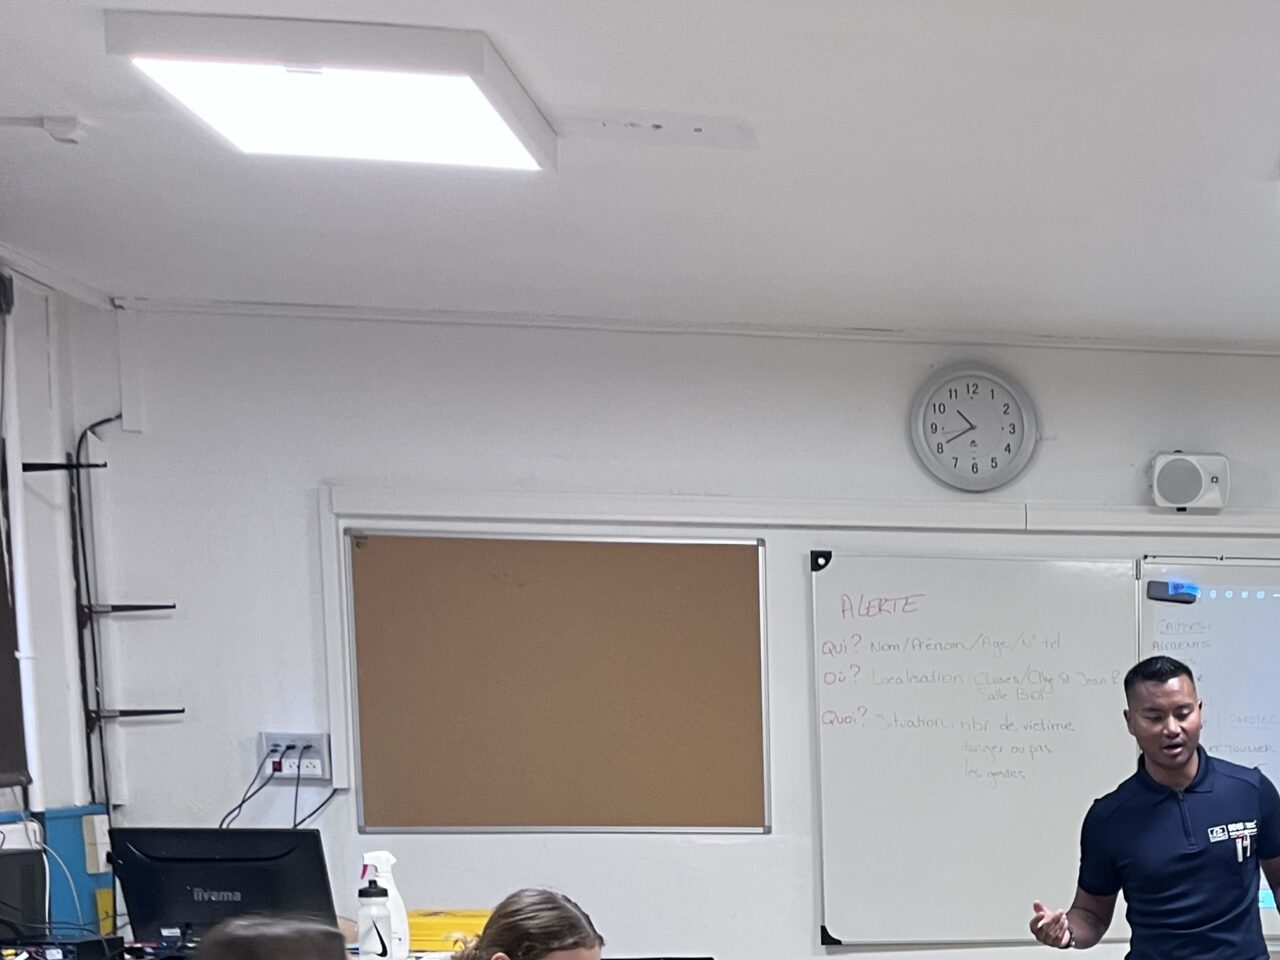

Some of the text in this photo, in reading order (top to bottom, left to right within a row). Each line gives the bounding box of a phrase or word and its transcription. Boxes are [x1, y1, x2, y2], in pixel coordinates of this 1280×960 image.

[949, 388, 958, 400] 11
[966, 383, 979, 395] 12
[990, 389, 995, 400] 1
[932, 403, 946, 414] 10
[1003, 403, 1010, 415] 2
[930, 423, 938, 434] 9
[1008, 423, 1016, 435] 3
[936, 442, 944, 454] 8
[1004, 442, 1011, 454] 4
[952, 457, 959, 468] 7
[971, 462, 979, 474] 6
[990, 457, 998, 469] 5
[841, 593, 926, 620] ALERTE
